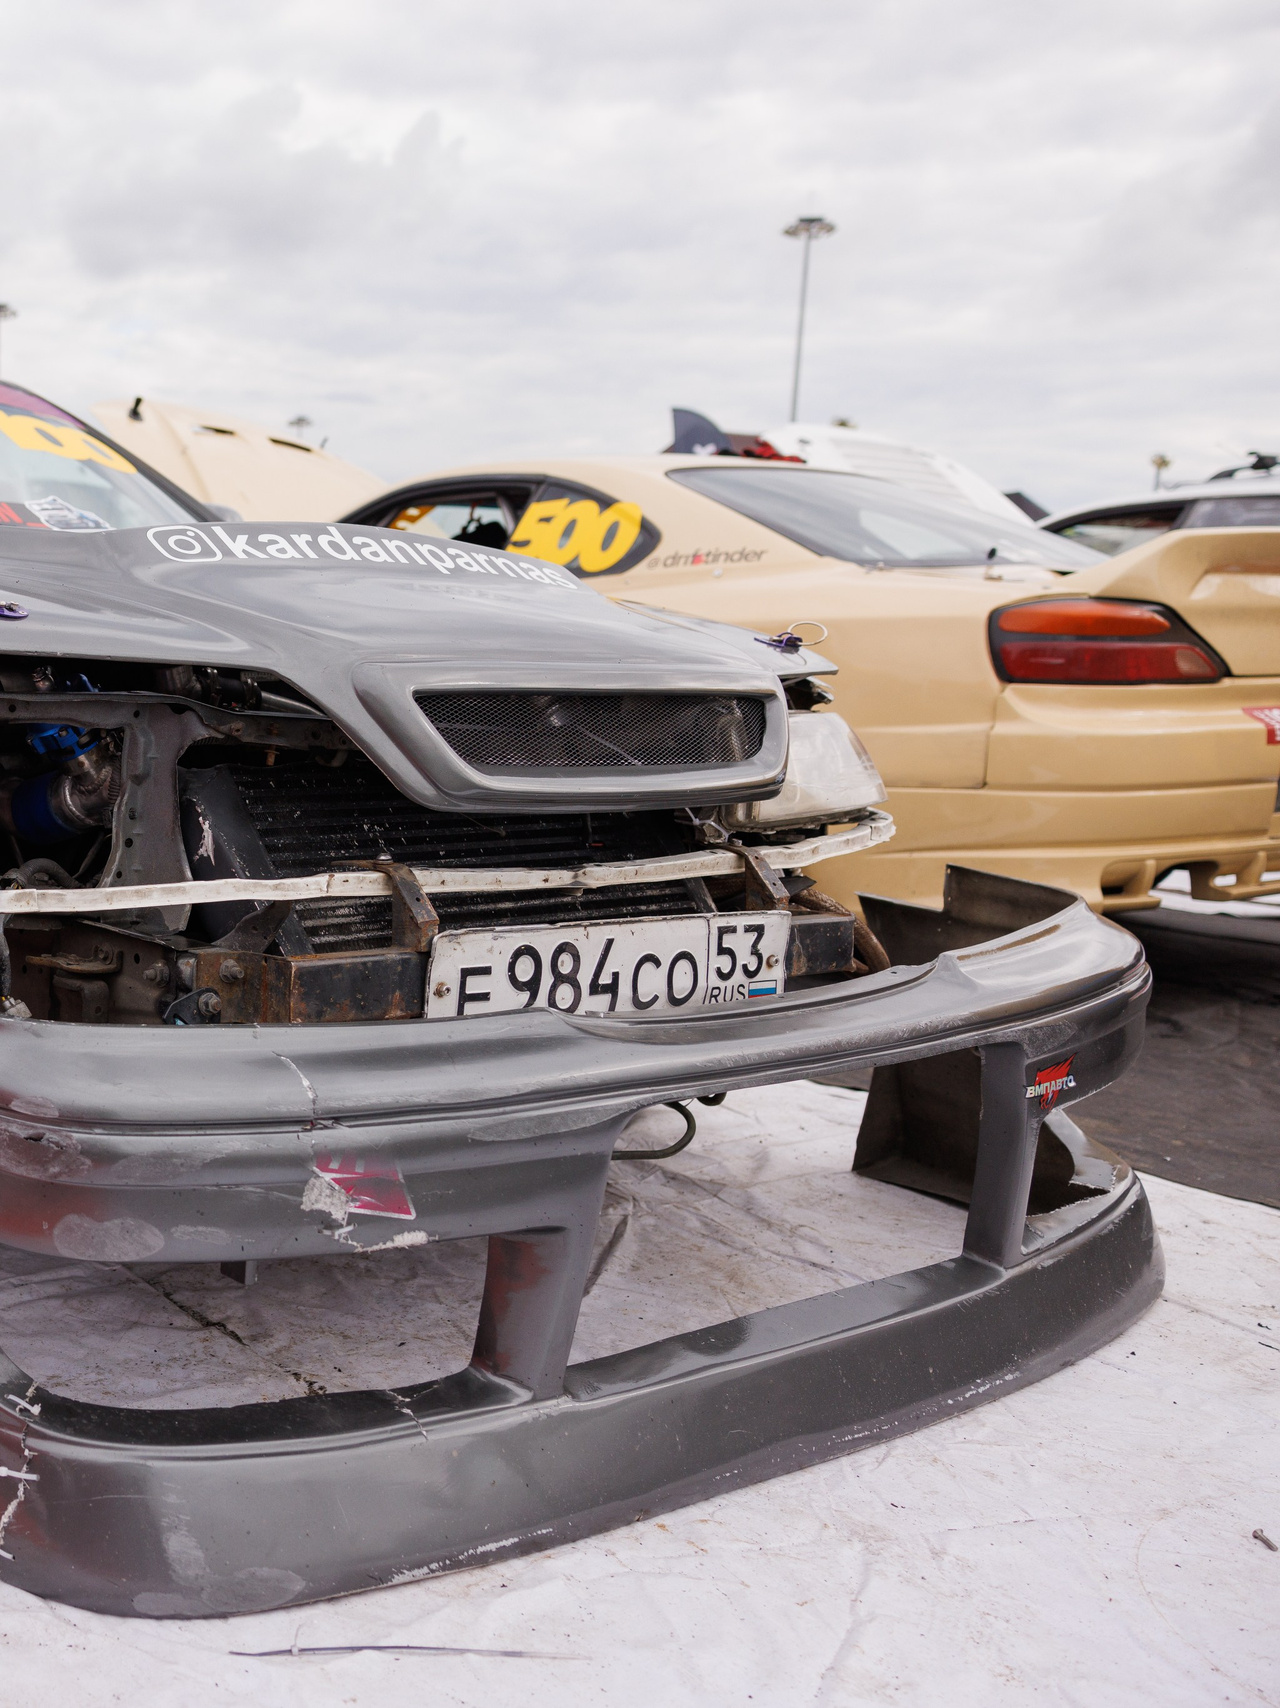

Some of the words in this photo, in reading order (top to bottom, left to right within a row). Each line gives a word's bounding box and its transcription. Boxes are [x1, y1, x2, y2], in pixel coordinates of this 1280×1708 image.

[211, 525, 578, 590] kardanparnas
[505, 498, 642, 573] 500
[715, 923, 766, 981] 53
[708, 983, 746, 1004] RUS
[1025, 1074, 1077, 1099] ВМПАВТО
